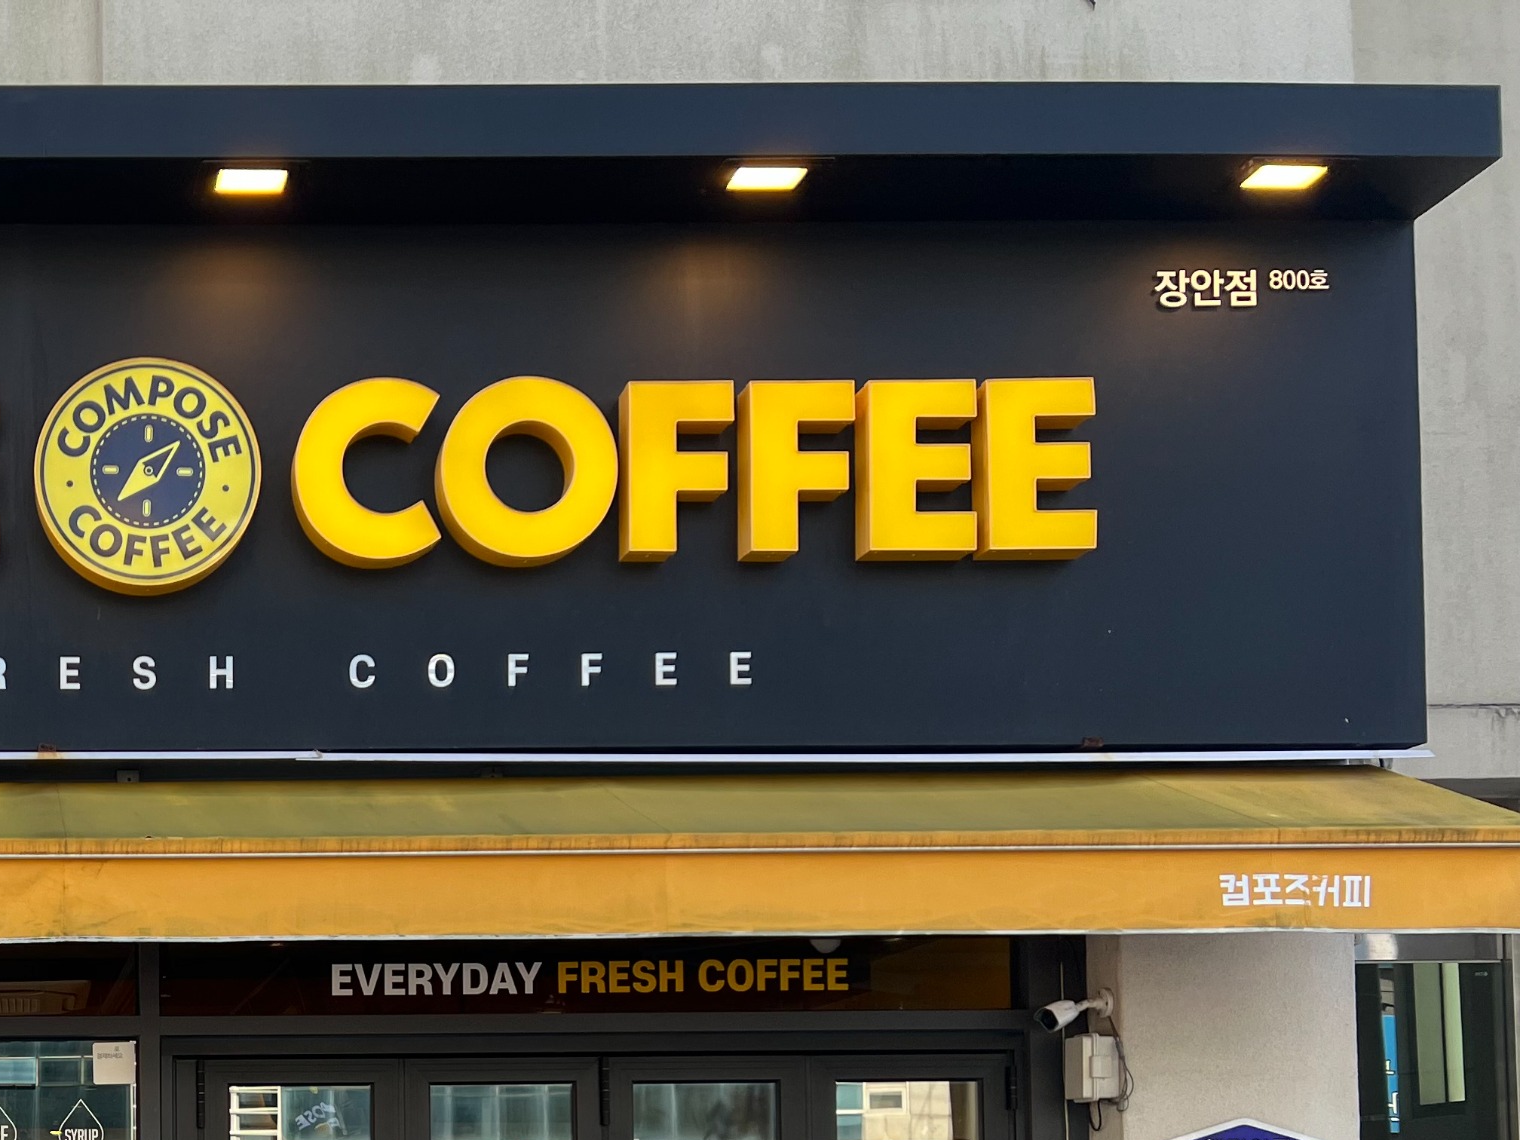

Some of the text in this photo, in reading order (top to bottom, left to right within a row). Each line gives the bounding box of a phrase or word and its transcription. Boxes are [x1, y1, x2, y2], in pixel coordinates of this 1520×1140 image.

[1154, 269, 1330, 308] 장안점 800호
[57, 375, 242, 463] COMPOSE
[291, 375, 1098, 570] COFFEE
[68, 505, 227, 568] COFFEE
[348, 652, 756, 690] COFFEE
[1219, 873, 1371, 908] 컴포즈커피
[331, 957, 850, 997] EVERYDAY FRESH COFFEE
